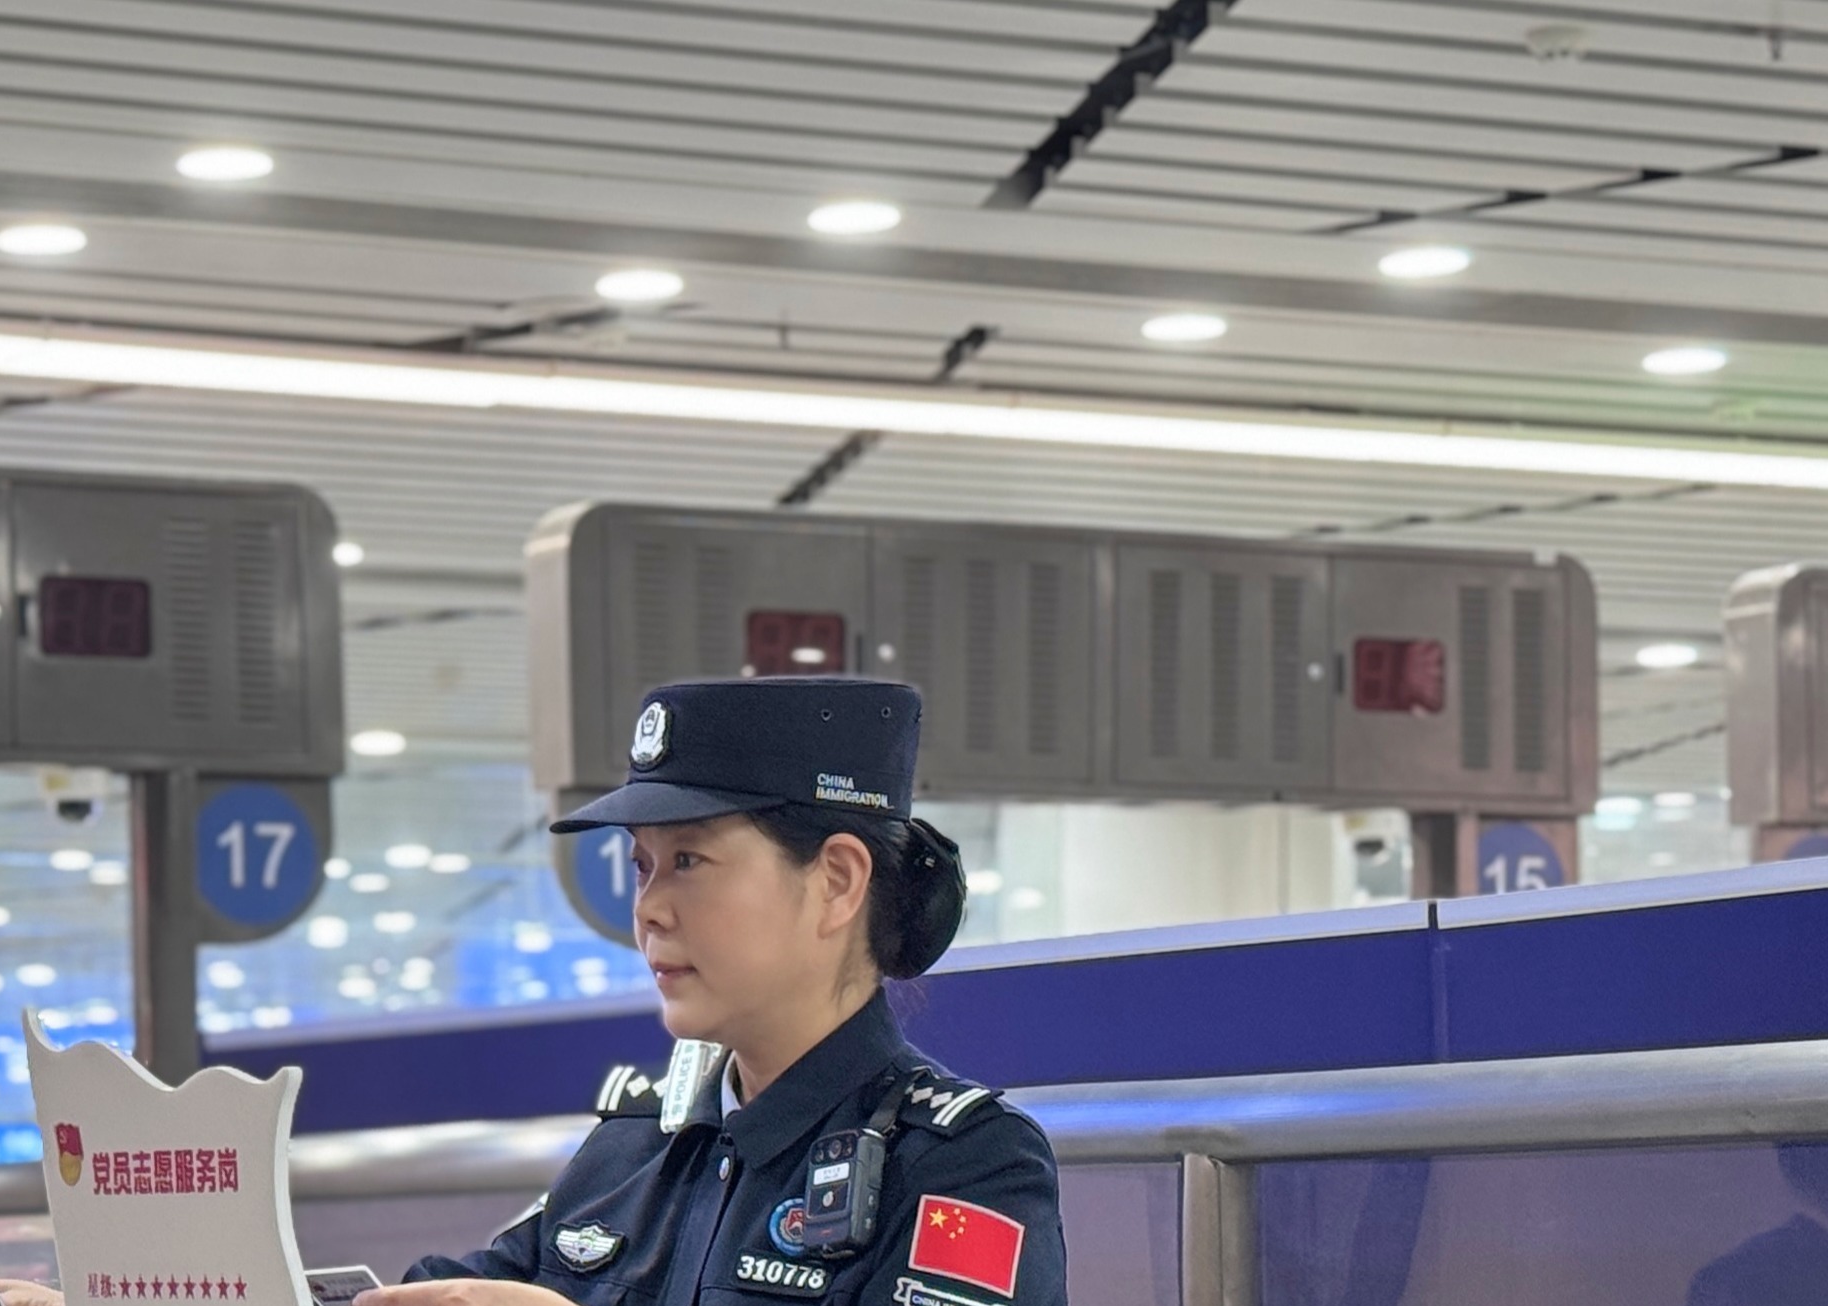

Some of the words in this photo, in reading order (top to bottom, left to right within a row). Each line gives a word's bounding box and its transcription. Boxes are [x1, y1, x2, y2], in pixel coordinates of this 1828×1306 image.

[815, 786, 889, 809] IMMIGRATION
[817, 773, 854, 790] CHINA
[216, 820, 296, 889] 17
[598, 832, 626, 898] 1
[674, 1056, 692, 1101] POLICE
[92, 1147, 239, 1195] 党员志愿服务岗
[736, 1255, 827, 1290] 310778
